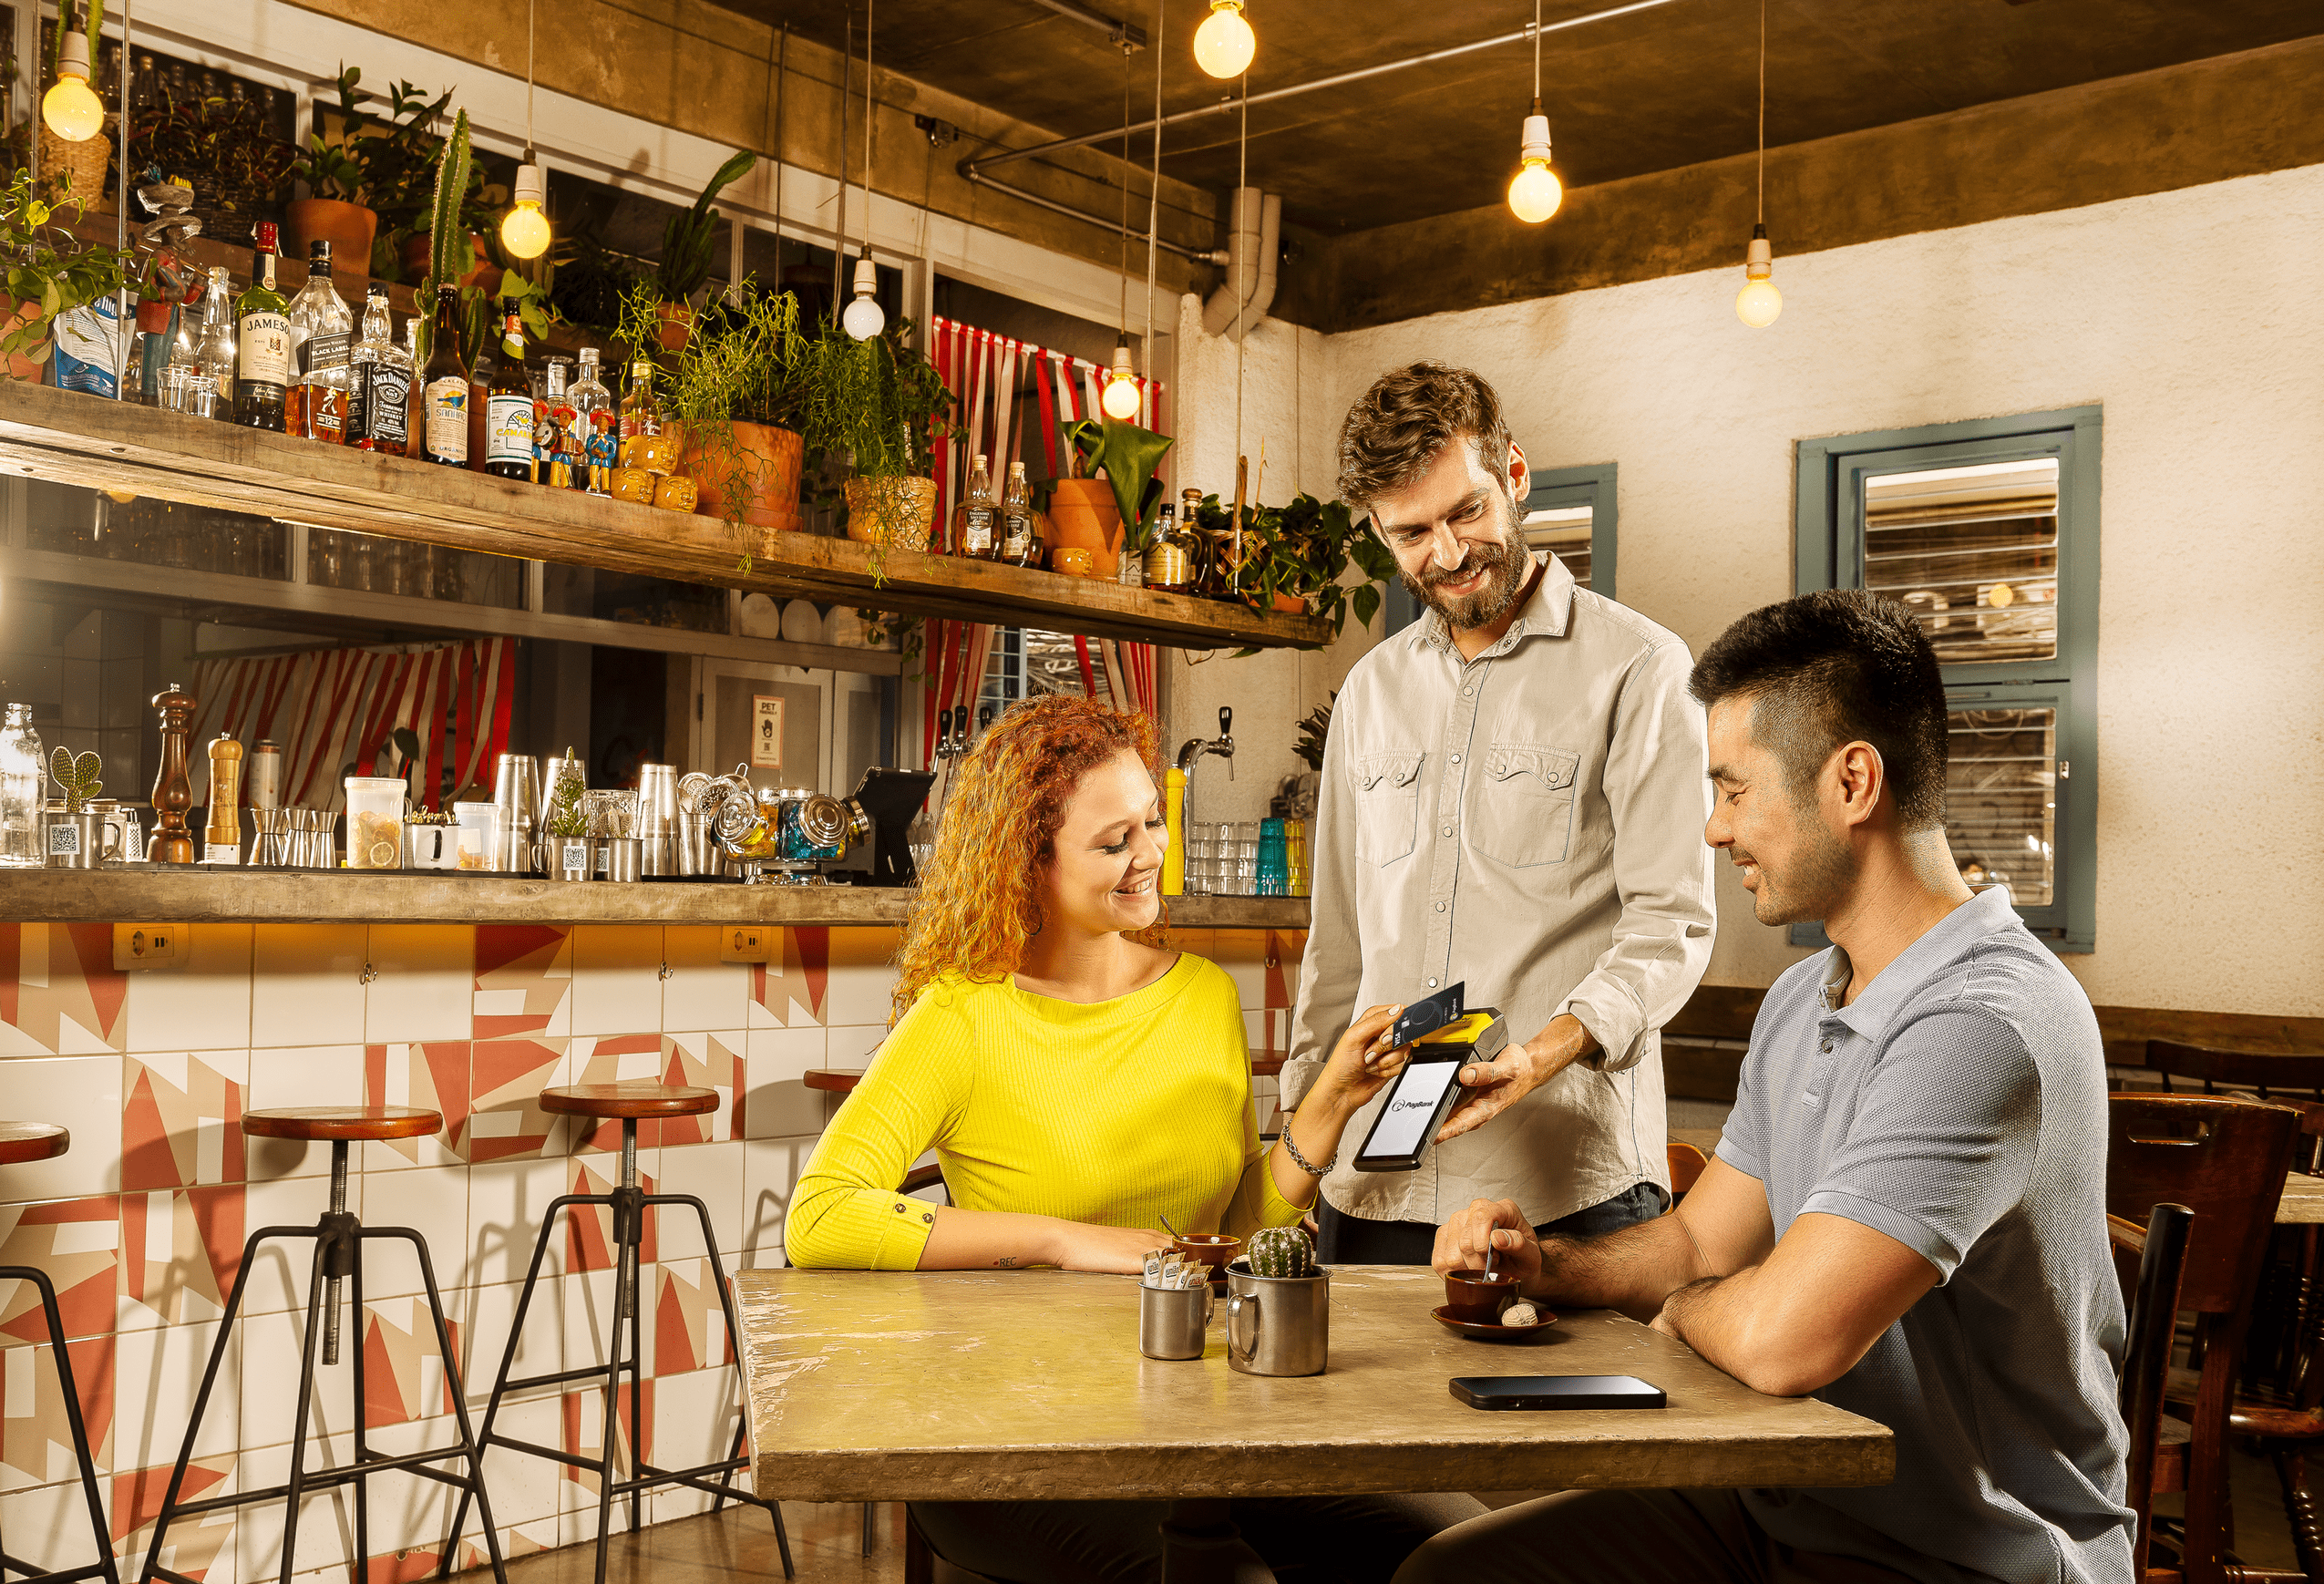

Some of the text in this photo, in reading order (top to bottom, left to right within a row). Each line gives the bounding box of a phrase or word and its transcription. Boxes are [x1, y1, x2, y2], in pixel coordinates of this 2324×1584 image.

[247, 318, 290, 334] JAMESO
[331, 345, 350, 353] LABEL
[372, 374, 388, 386] JACK
[379, 411, 403, 420] WHISKEY
[325, 417, 333, 426] 12
[1405, 1100, 1434, 1109] PagBank
[999, 1256, 1017, 1268] REC
